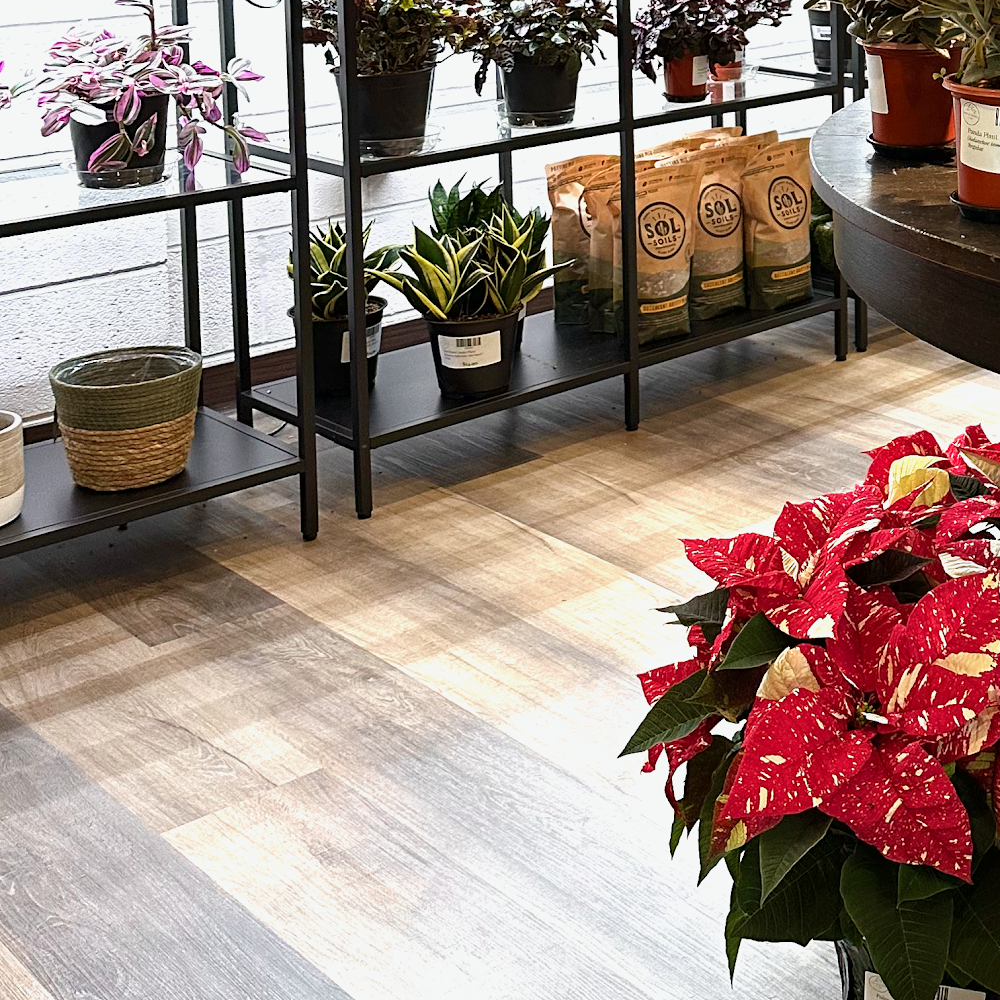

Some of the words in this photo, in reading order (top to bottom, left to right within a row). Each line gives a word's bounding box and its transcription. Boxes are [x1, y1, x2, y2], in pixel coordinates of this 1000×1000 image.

[967, 127, 983, 137] Panda
[773, 191, 803, 211] SOL
[704, 198, 737, 218] SOL
[781, 206, 801, 217] SOILS
[711, 214, 734, 225] SOILS
[644, 217, 681, 239] SOL
[653, 235, 677, 246] SOILS
